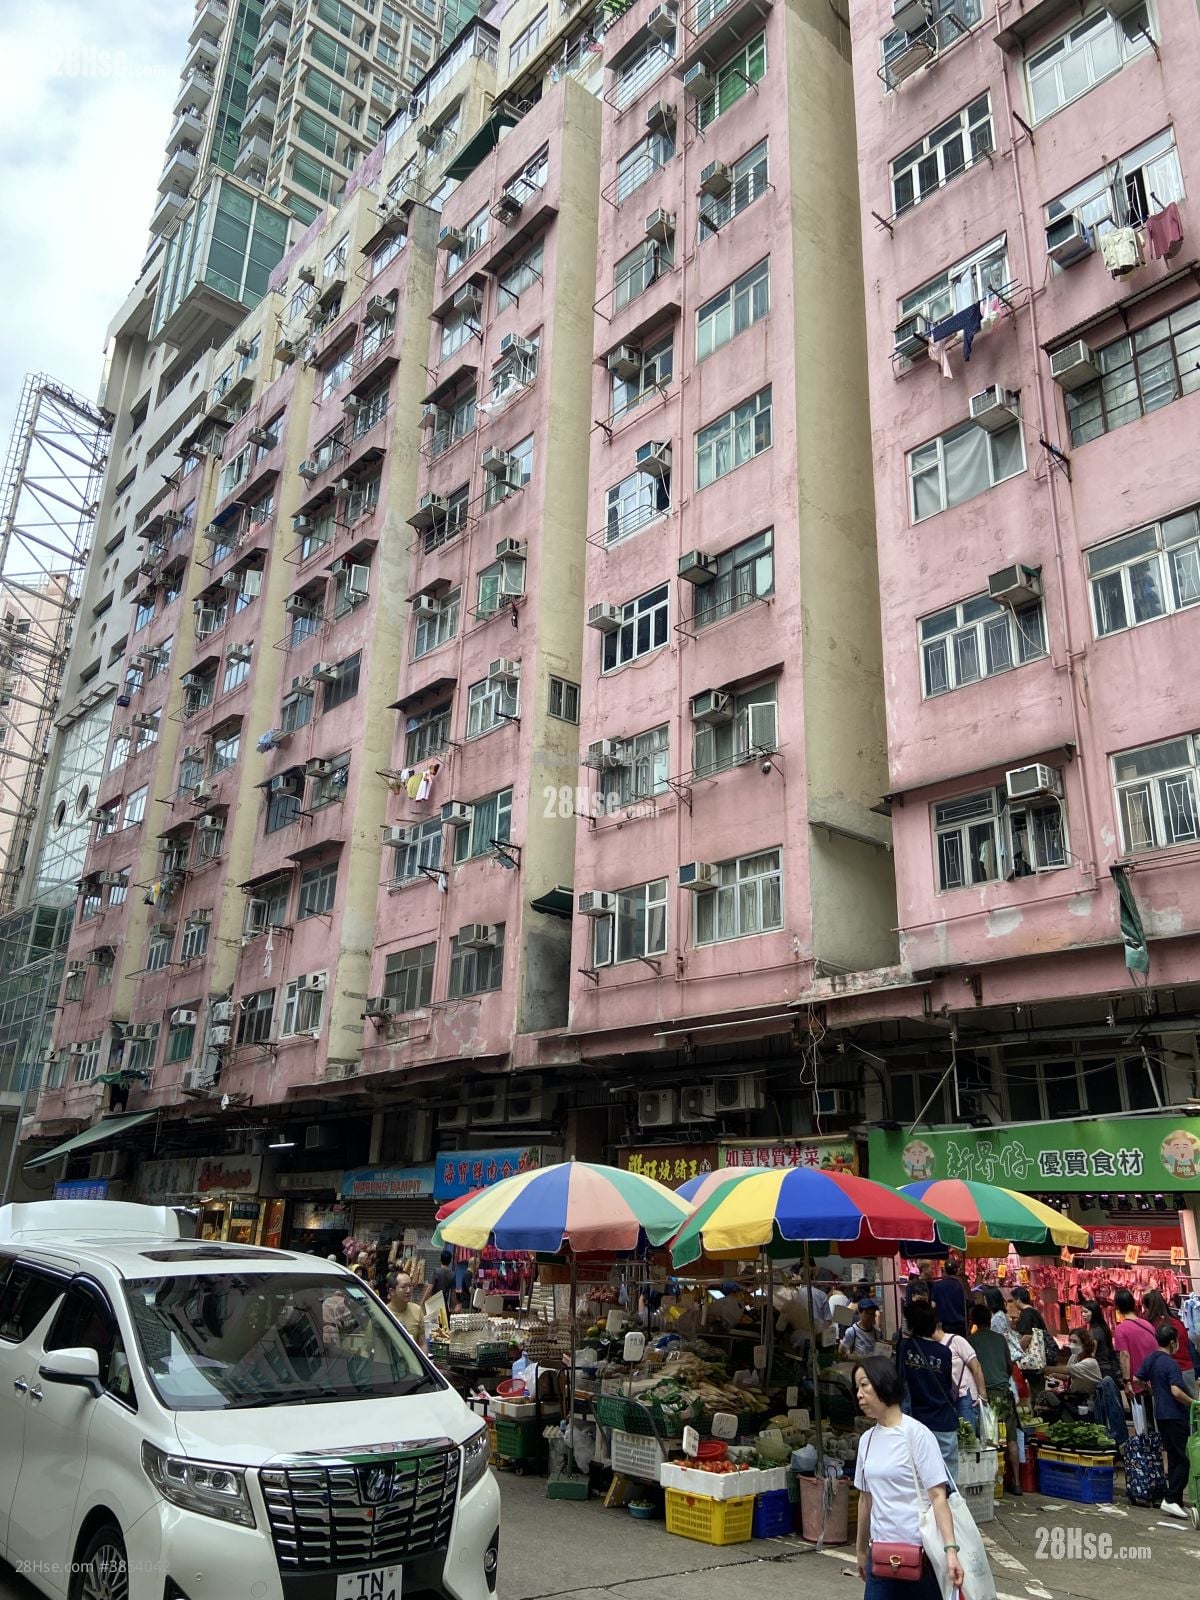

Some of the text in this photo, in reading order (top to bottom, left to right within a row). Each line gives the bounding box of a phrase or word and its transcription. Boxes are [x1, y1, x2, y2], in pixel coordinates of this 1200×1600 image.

[725, 1146, 820, 1168] 如意優質果菜
[947, 1140, 1145, 1181] 新界仔 優質食材
[352, 1178, 423, 1194] WARUNG DAMPIT
[357, 1570, 385, 1596] TN
